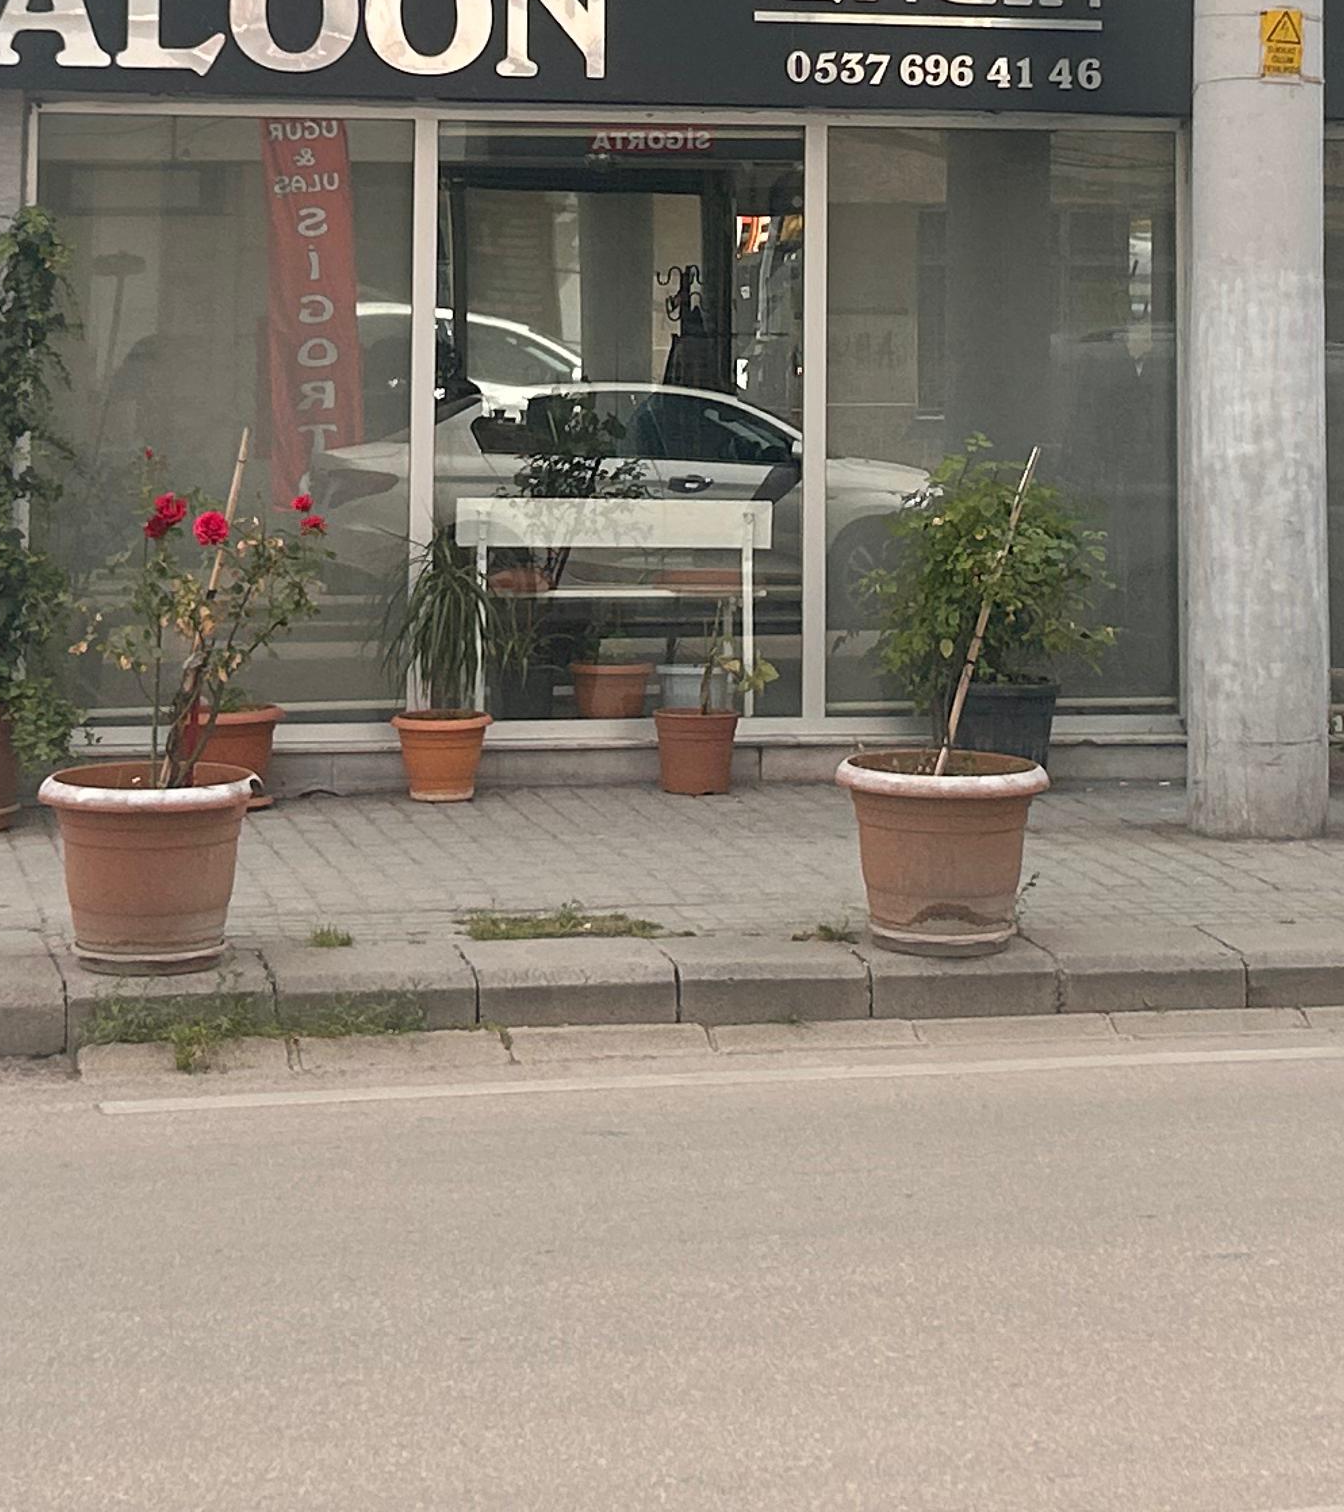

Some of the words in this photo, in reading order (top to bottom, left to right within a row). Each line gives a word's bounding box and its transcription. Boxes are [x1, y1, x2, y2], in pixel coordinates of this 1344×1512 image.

[787, 50, 891, 86] 0537
[899, 53, 974, 87] 696
[986, 55, 1033, 88] 41
[1048, 57, 1102, 90] 46
